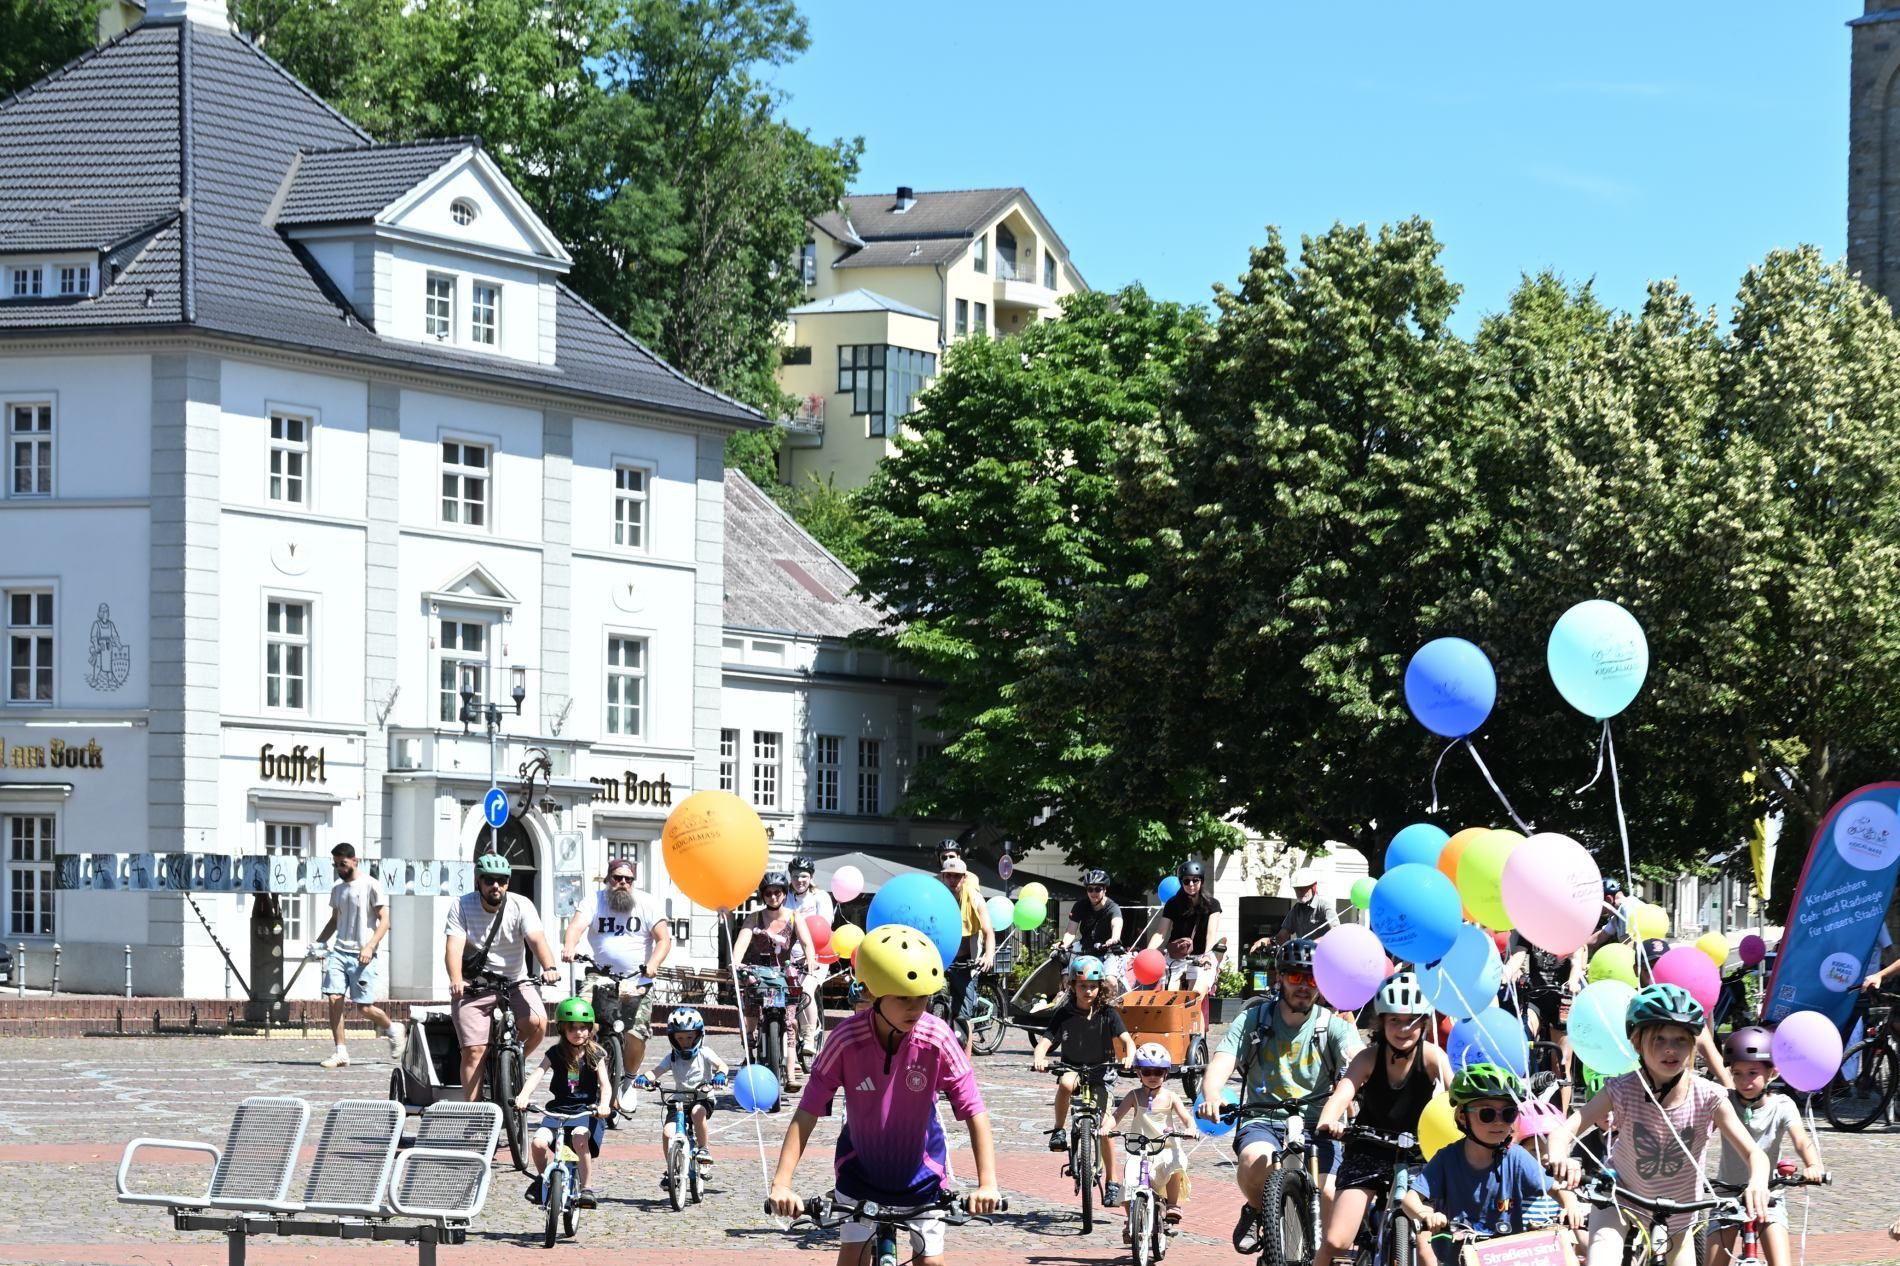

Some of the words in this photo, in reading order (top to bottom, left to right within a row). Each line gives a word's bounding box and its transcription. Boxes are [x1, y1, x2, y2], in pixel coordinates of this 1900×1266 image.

[10, 746, 46, 769] am
[49, 736, 104, 769] Bock
[259, 742, 327, 787] Gaffel
[624, 770, 672, 808] Bock
[1799, 911, 1821, 925] Geh-
[1822, 902, 1840, 917] und
[1841, 890, 1884, 910] Radwege
[1805, 880, 1868, 906] Kindersichere
[1824, 916, 1855, 932] unsere
[1855, 903, 1885, 922] Stadt!
[1482, 1246, 1534, 1265] Straßen
